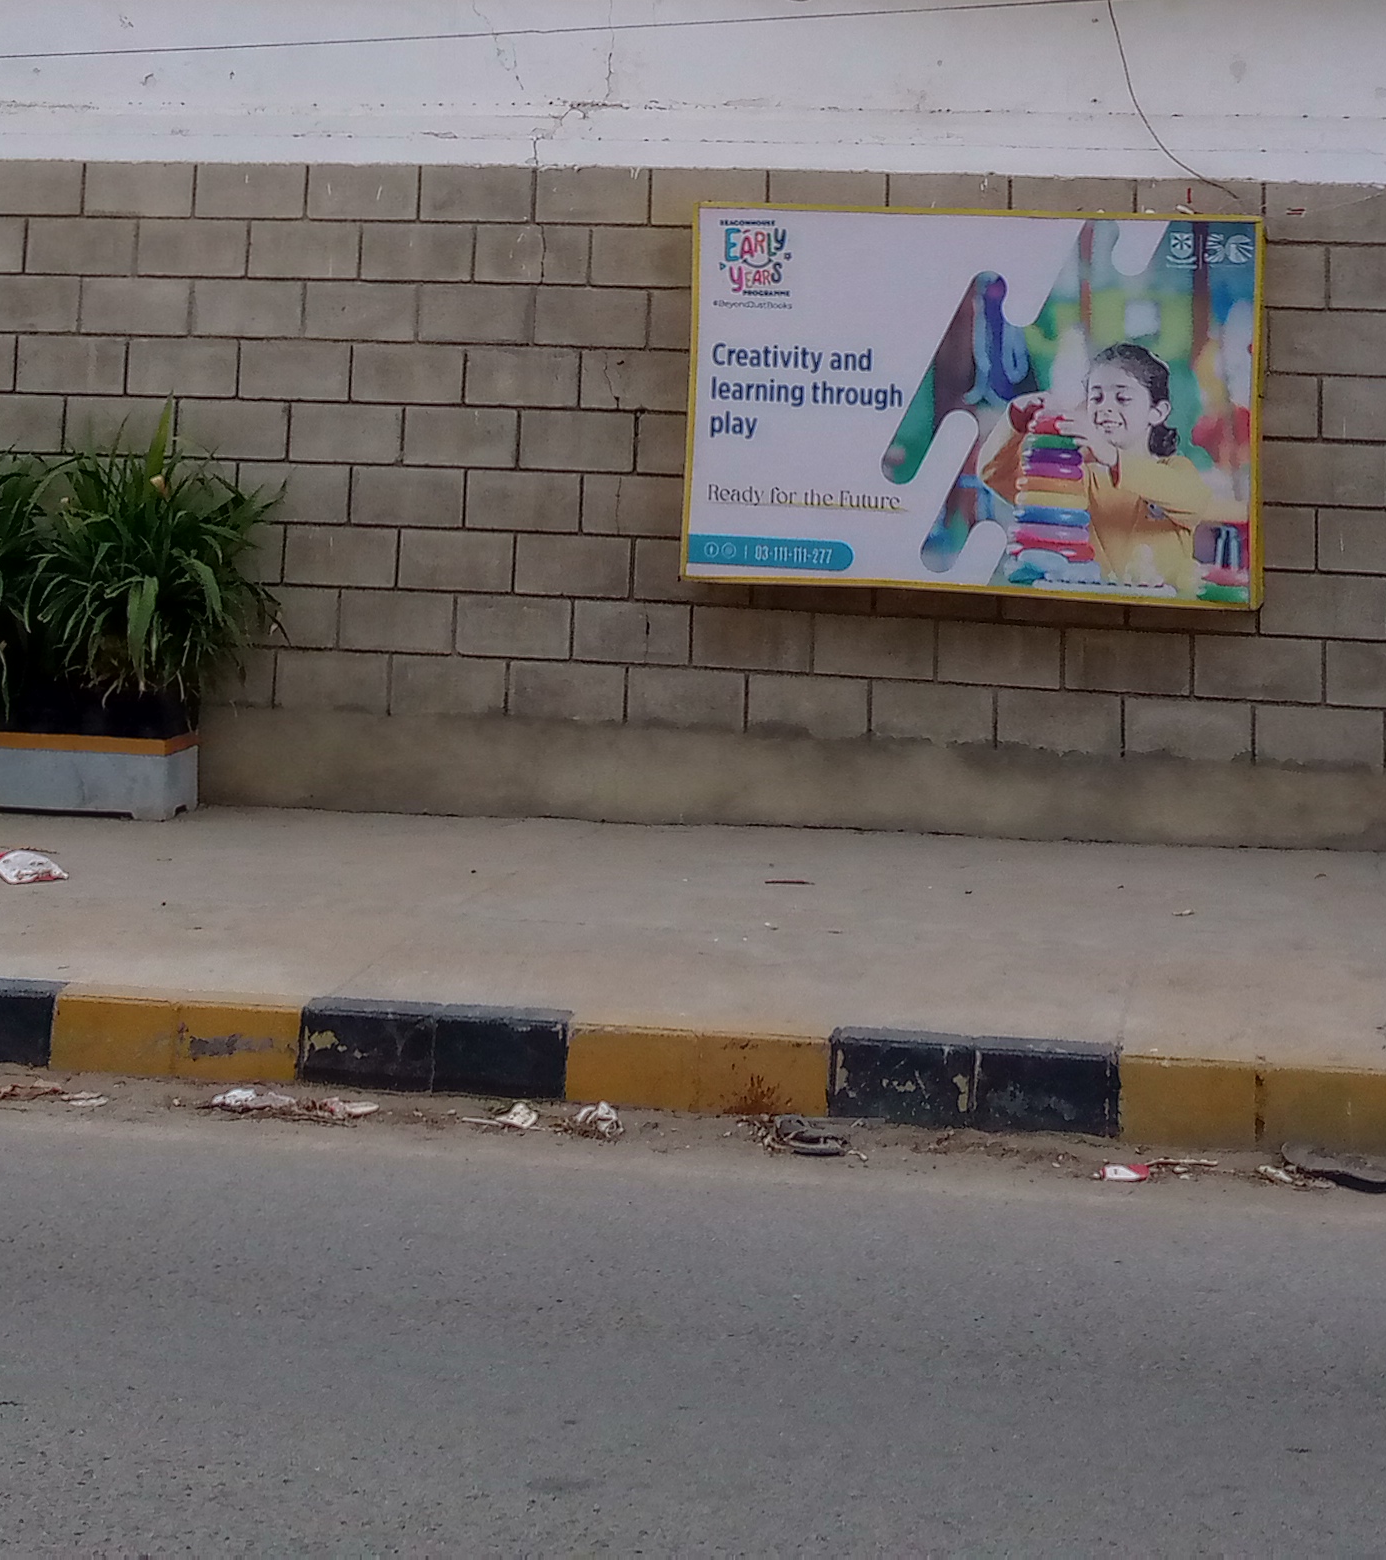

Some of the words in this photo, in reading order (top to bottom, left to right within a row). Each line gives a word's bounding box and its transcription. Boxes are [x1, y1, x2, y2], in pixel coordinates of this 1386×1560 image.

[729, 262, 783, 292] YEARS
[712, 343, 823, 374] Creativity
[829, 347, 873, 372] and
[711, 376, 805, 406] learning
[812, 380, 903, 410] through
[710, 411, 758, 439] play
[707, 484, 763, 506] Ready
[770, 486, 797, 504] for
[804, 488, 834, 507] the
[839, 490, 901, 510] Future
